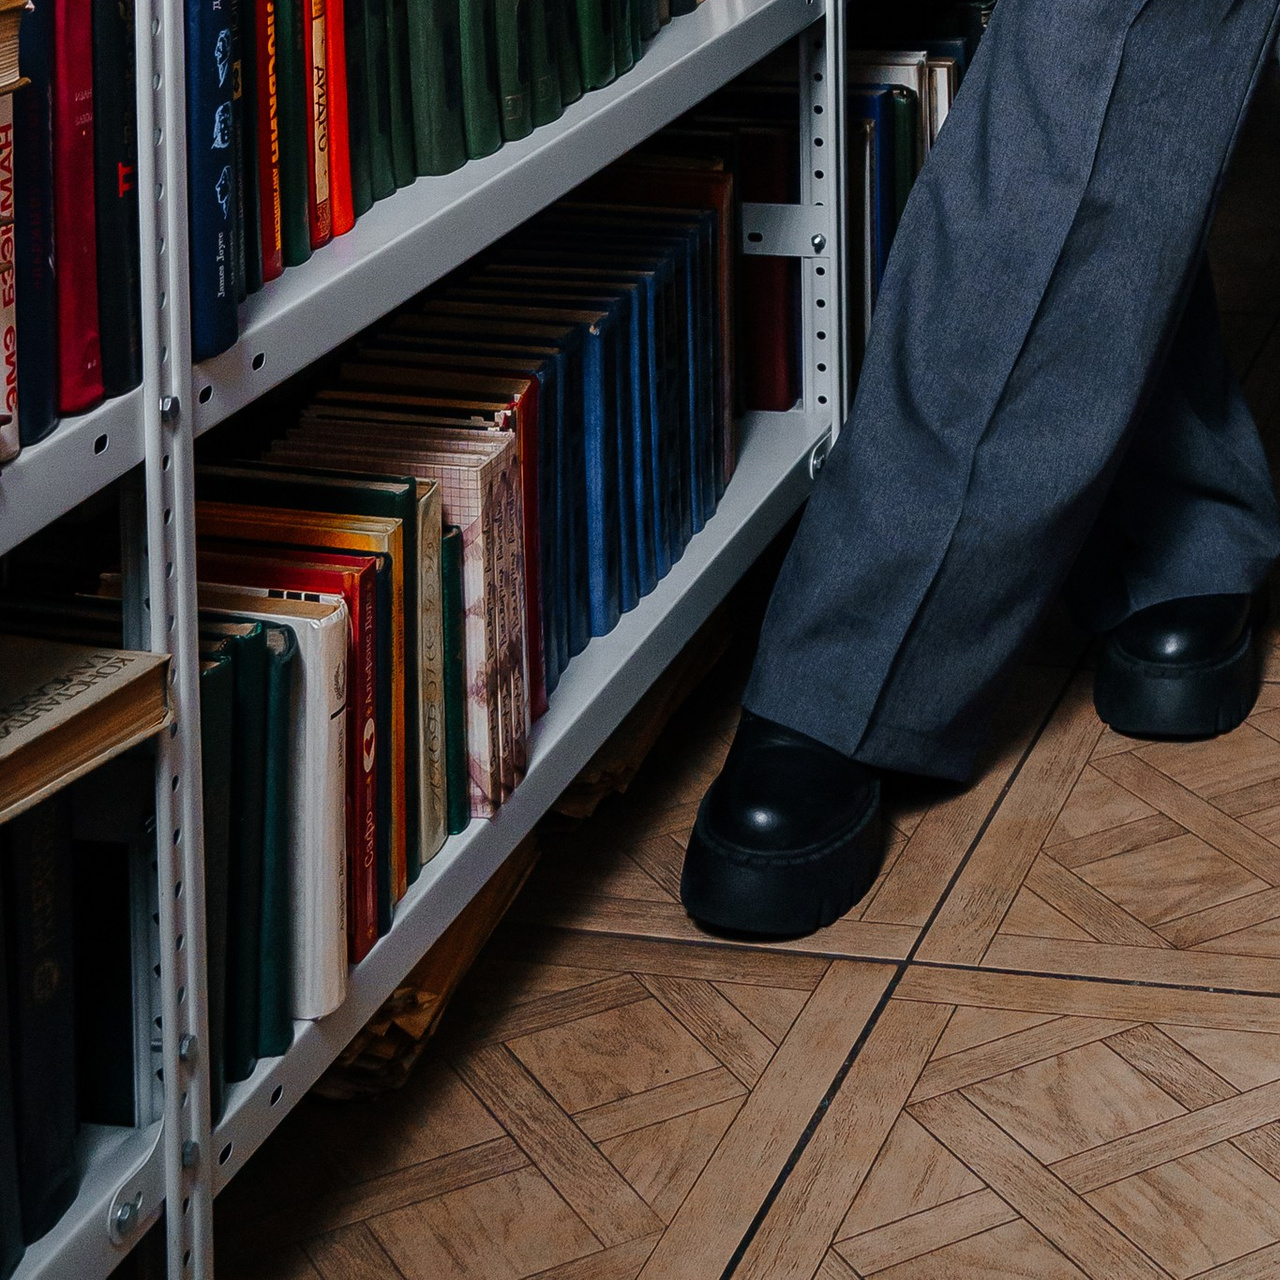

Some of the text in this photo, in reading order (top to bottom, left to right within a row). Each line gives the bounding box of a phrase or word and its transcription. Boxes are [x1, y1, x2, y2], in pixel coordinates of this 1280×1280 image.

[215, 231, 226, 298] James Joyce
[5, 325, 18, 413] ЭМЭ
[364, 634, 375, 705] Альфонс
[364, 811, 376, 870] Сафо
